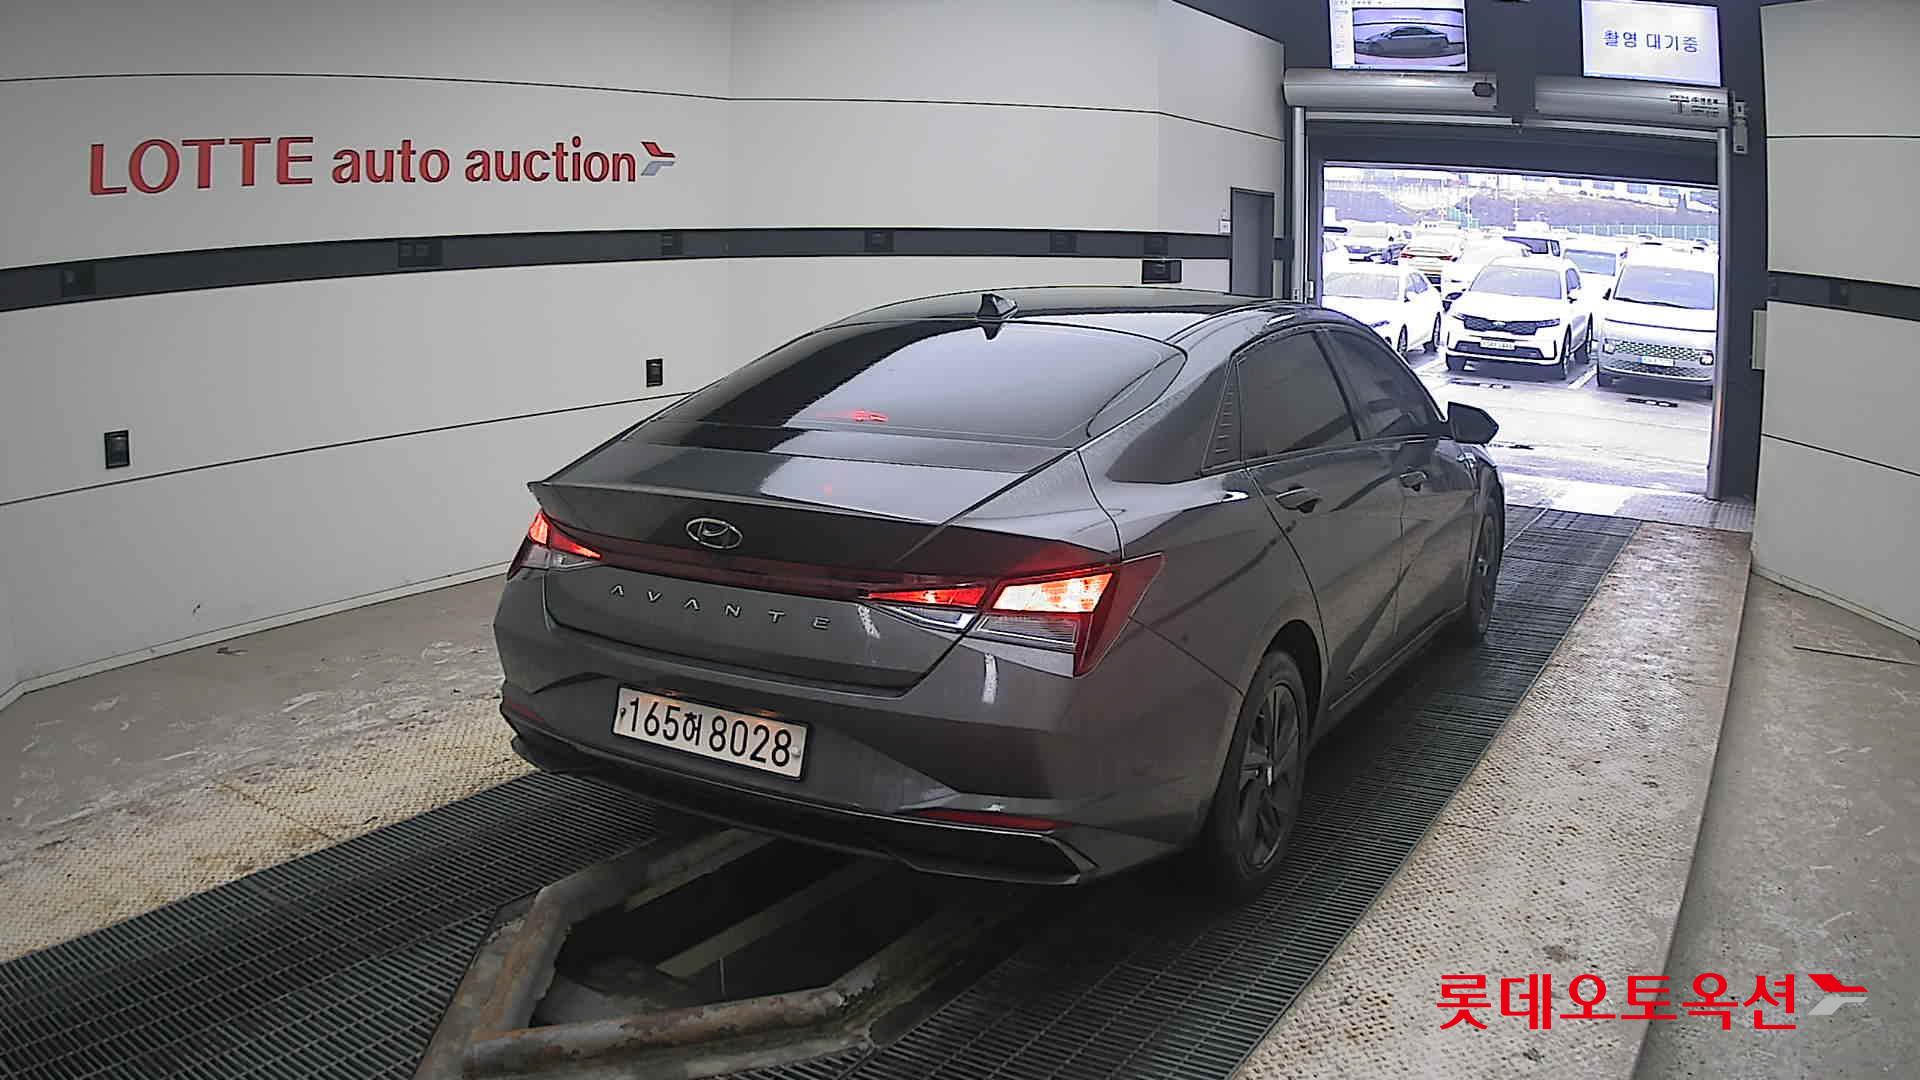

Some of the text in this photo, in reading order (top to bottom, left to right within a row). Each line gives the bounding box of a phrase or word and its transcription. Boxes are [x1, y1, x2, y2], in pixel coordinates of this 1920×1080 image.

[1602, 30, 1698, 53] 촬영 대기중
[88, 136, 637, 196] LOTTE auto auction
[610, 583, 831, 630] AVANTE
